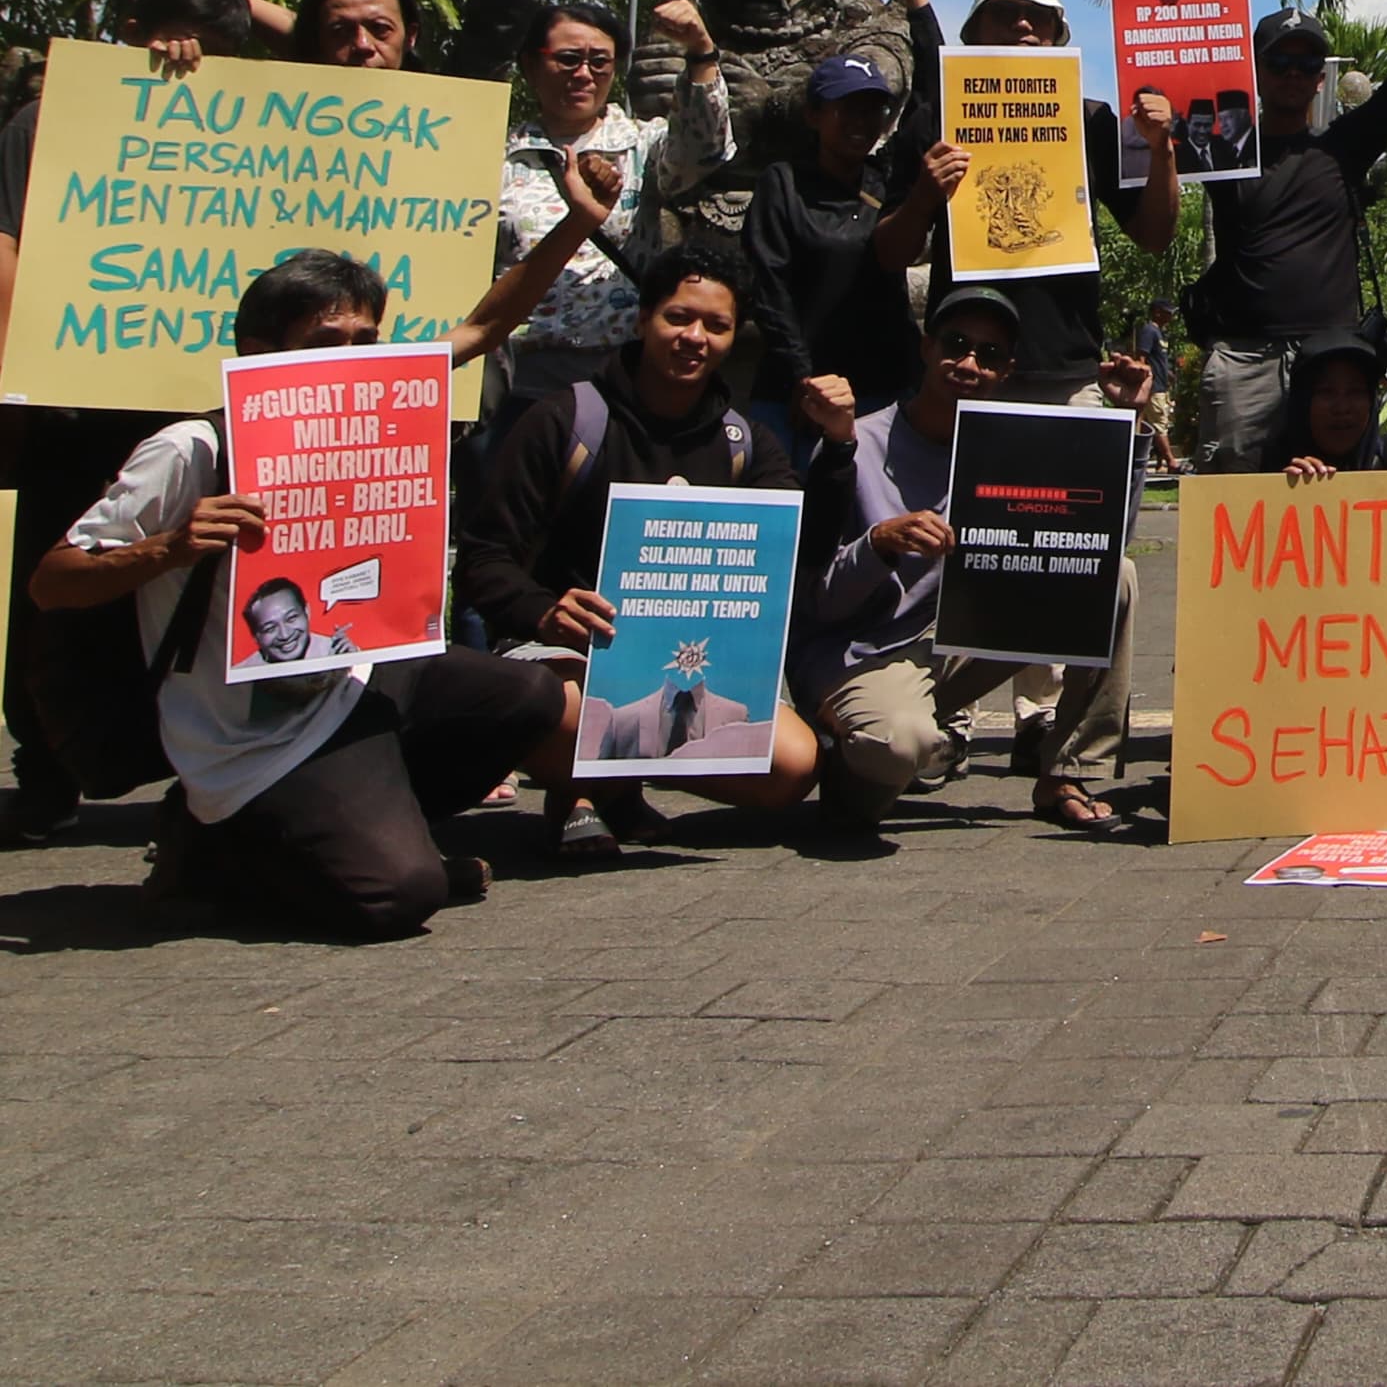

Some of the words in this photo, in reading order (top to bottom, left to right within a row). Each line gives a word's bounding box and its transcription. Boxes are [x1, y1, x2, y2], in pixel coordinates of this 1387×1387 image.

[1136, 6, 1151, 22] RP
[1155, 5, 1178, 21] 200
[1181, 3, 1220, 20] MILIAR
[1124, 26, 1204, 45] BANGKRUTKAN
[1208, 24, 1243, 39] MEDIA
[1135, 50, 1177, 67] BREDEL
[1180, 48, 1209, 64] GAYA
[1212, 46, 1244, 61] BARU.
[964, 78, 1000, 94] REZIM
[1005, 78, 1056, 94] OTORITER
[122, 77, 245, 134] TAU
[258, 91, 451, 151] NGGAK
[962, 103, 997, 118] TAKUT
[1002, 102, 1060, 118] TERHADAP
[956, 127, 993, 144] MEDIA
[999, 127, 1028, 143] YANG
[1032, 126, 1067, 142] KRITIS
[118, 136, 391, 189] PERSAMAAN
[59, 172, 262, 228] MENTAN
[302, 189, 492, 237] MANTAN?
[242, 383, 346, 423] #GUGAT
[354, 381, 384, 412] RP
[392, 378, 439, 409] 200
[294, 415, 380, 449] MILIAR
[256, 444, 429, 487] BANGKRUTKAN
[248, 486, 327, 521] MEDIA
[353, 477, 437, 513] BREDEL
[272, 521, 335, 555] GAYA
[344, 513, 413, 549] BARU.
[644, 519, 703, 539] MENTAN
[706, 521, 758, 541] AMRAN
[961, 527, 1029, 548] LOADING...
[1034, 530, 1109, 551] KEBEBASAN
[639, 546, 712, 565] SULAIMAN
[716, 549, 756, 567] TIDAK
[965, 553, 998, 570] PERS
[1002, 555, 1044, 572] GAGAL
[1049, 557, 1100, 575] DIMUAT
[620, 572, 688, 590] MEMILIKI
[691, 574, 719, 592] HAK
[723, 575, 768, 593] UNTUK
[621, 598, 708, 618] MENGGUGAT
[712, 601, 760, 619] TEMPO
